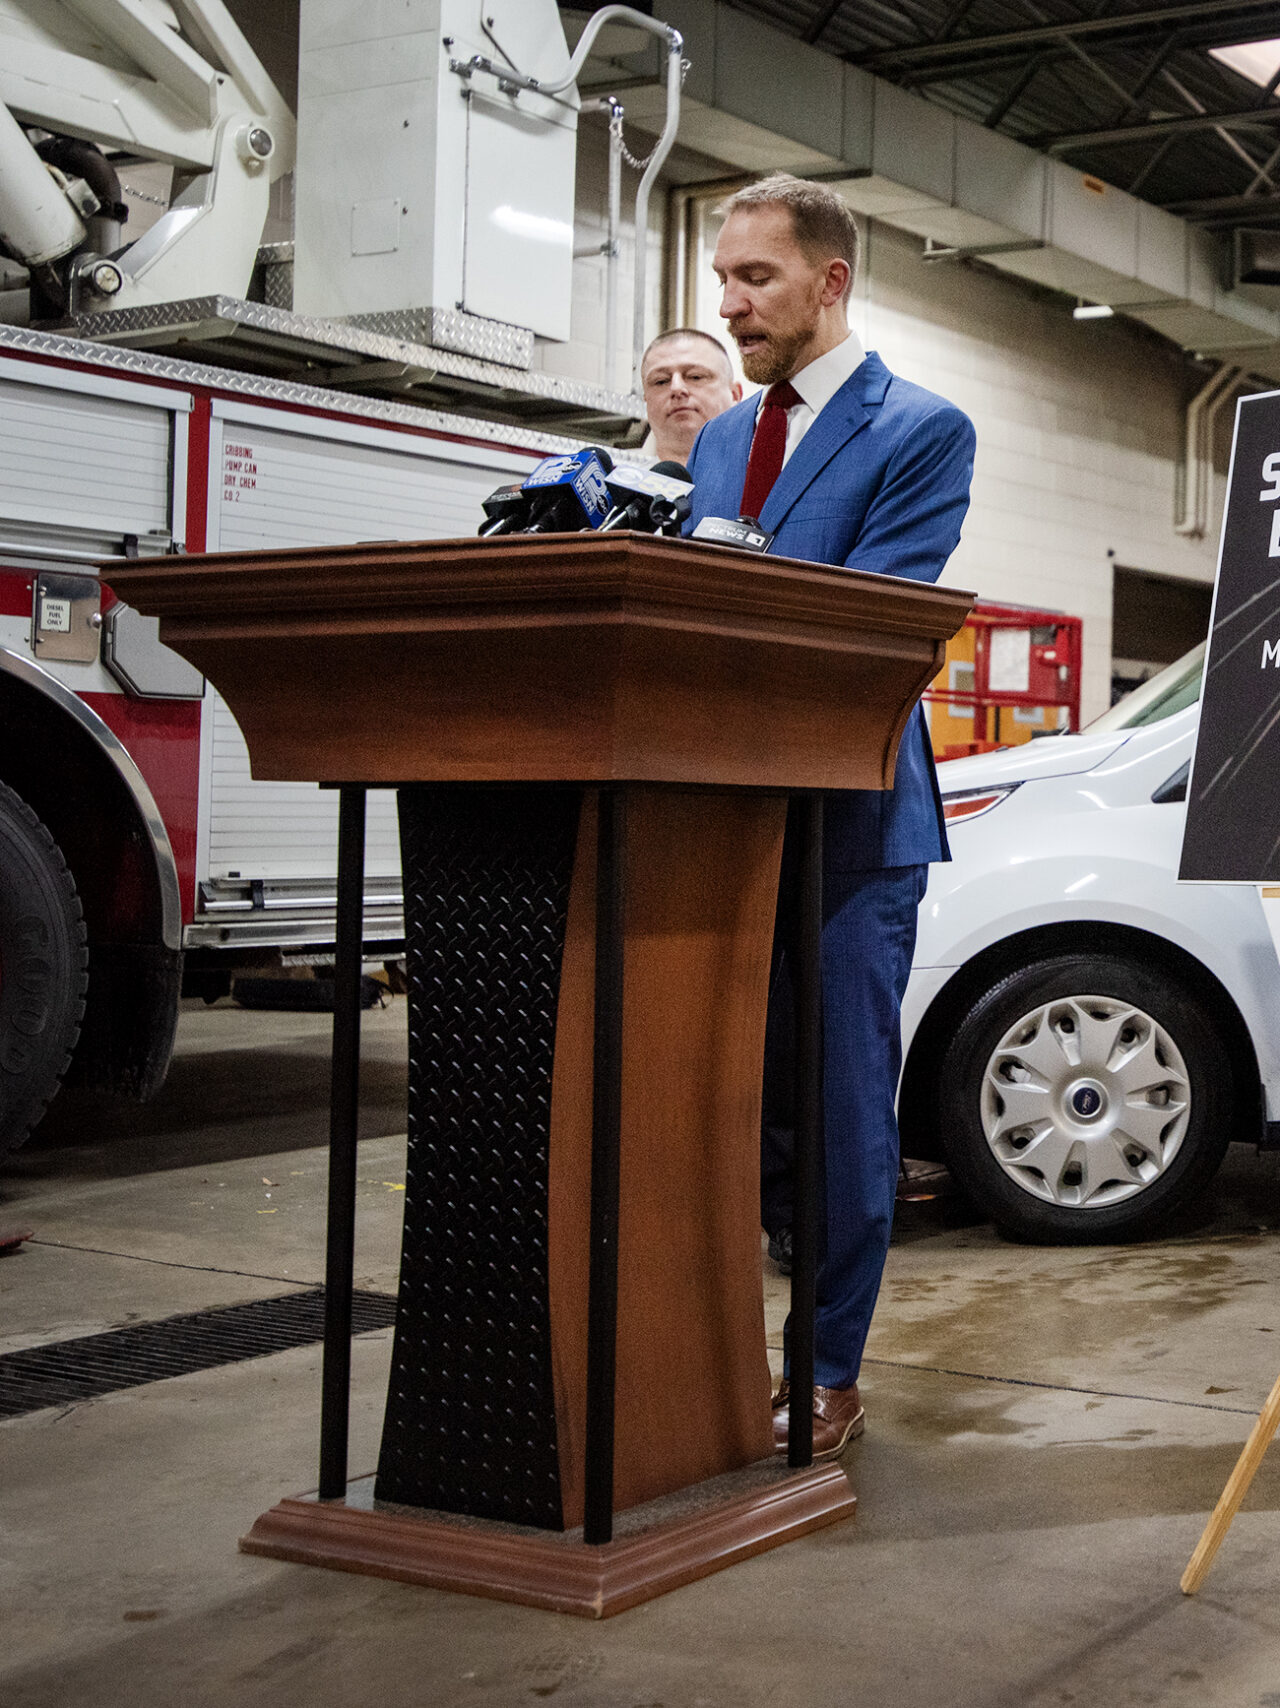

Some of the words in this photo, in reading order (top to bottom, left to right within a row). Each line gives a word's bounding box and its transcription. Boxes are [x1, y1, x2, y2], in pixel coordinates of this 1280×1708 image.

[225, 444, 253, 459] CRIBBING
[225, 460, 243, 472] PUMP
[244, 463, 257, 475] CAN
[224, 474, 236, 487] DRY
[239, 476, 257, 489] CHEM
[639, 475, 688, 498] 58
[575, 479, 595, 513] WISN
[709, 527, 744, 540] NEWS
